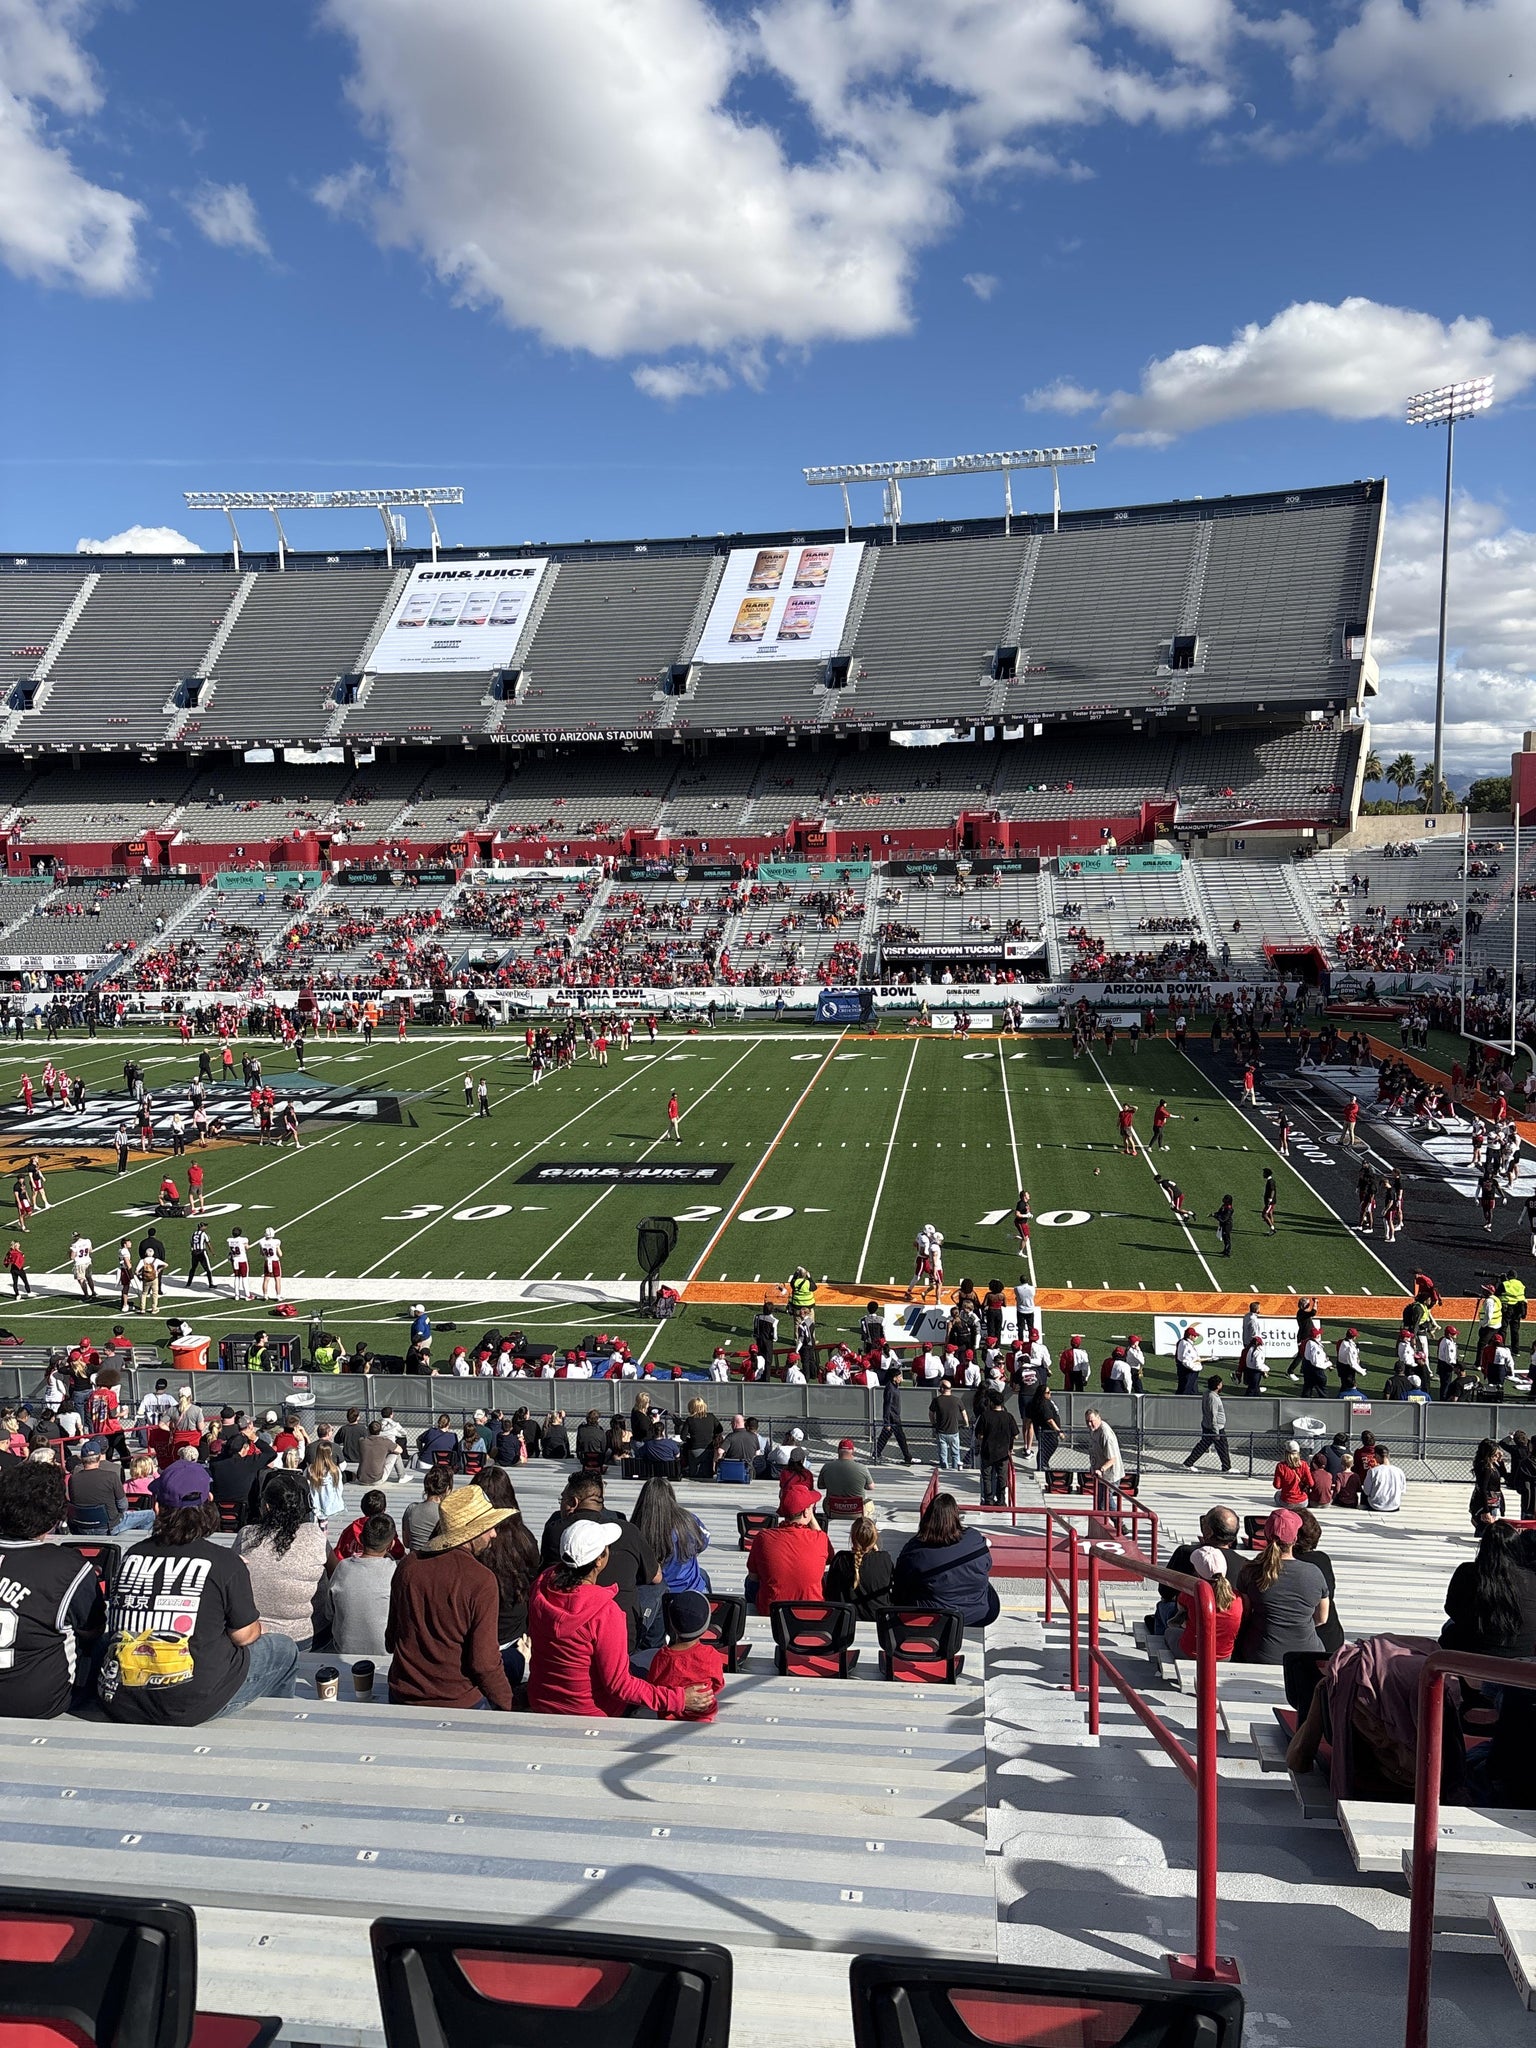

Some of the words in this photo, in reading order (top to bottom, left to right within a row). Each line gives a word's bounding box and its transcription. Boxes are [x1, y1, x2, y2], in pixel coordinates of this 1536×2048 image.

[490, 733, 541, 743] WELCOME
[543, 733, 557, 742] TO
[560, 732, 604, 741] ARIZONA
[606, 730, 653, 740] STADIUM
[128, 843, 146, 851] CW
[884, 947, 906, 955] VISIT
[908, 946, 963, 955] DOWNTOWN
[964, 946, 1002, 954] TUCSON
[612, 989, 647, 999] BOWL
[880, 986, 917, 997] BOWL
[1103, 984, 1164, 995] ARIZONA
[352, 992, 384, 1001] BOWL
[381, 1204, 513, 1221] 30
[672, 1206, 796, 1222] 20
[975, 1209, 1093, 1227] 10
[1207, 1327, 1240, 1338] Pain
[198, 1347, 208, 1366] G
[123, 1594, 150, 1610] 東京
[1490, 1917, 1512, 1962] ROW
[1512, 1961, 1526, 1993] 35
